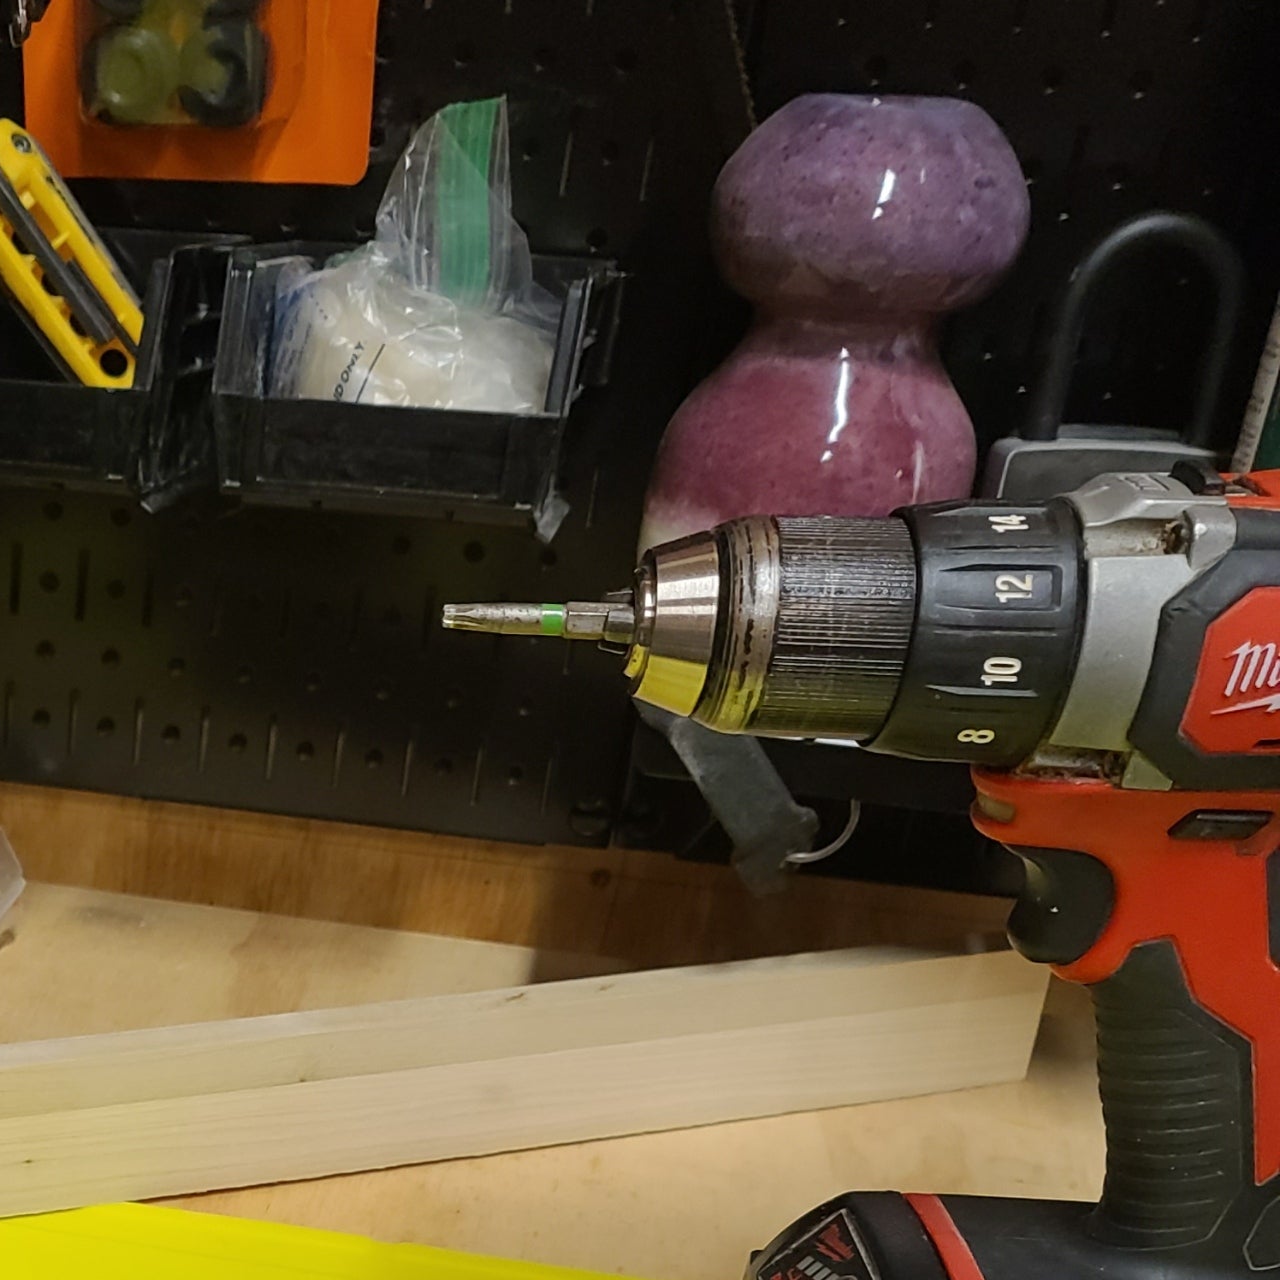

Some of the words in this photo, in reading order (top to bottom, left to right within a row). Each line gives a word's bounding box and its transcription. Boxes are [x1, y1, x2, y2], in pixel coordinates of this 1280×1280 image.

[340, 341, 365, 384] ONLY
[988, 513, 1030, 533] 14
[995, 574, 1034, 604] 12
[980, 656, 1022, 687] 10
[957, 729, 995, 744] 8
